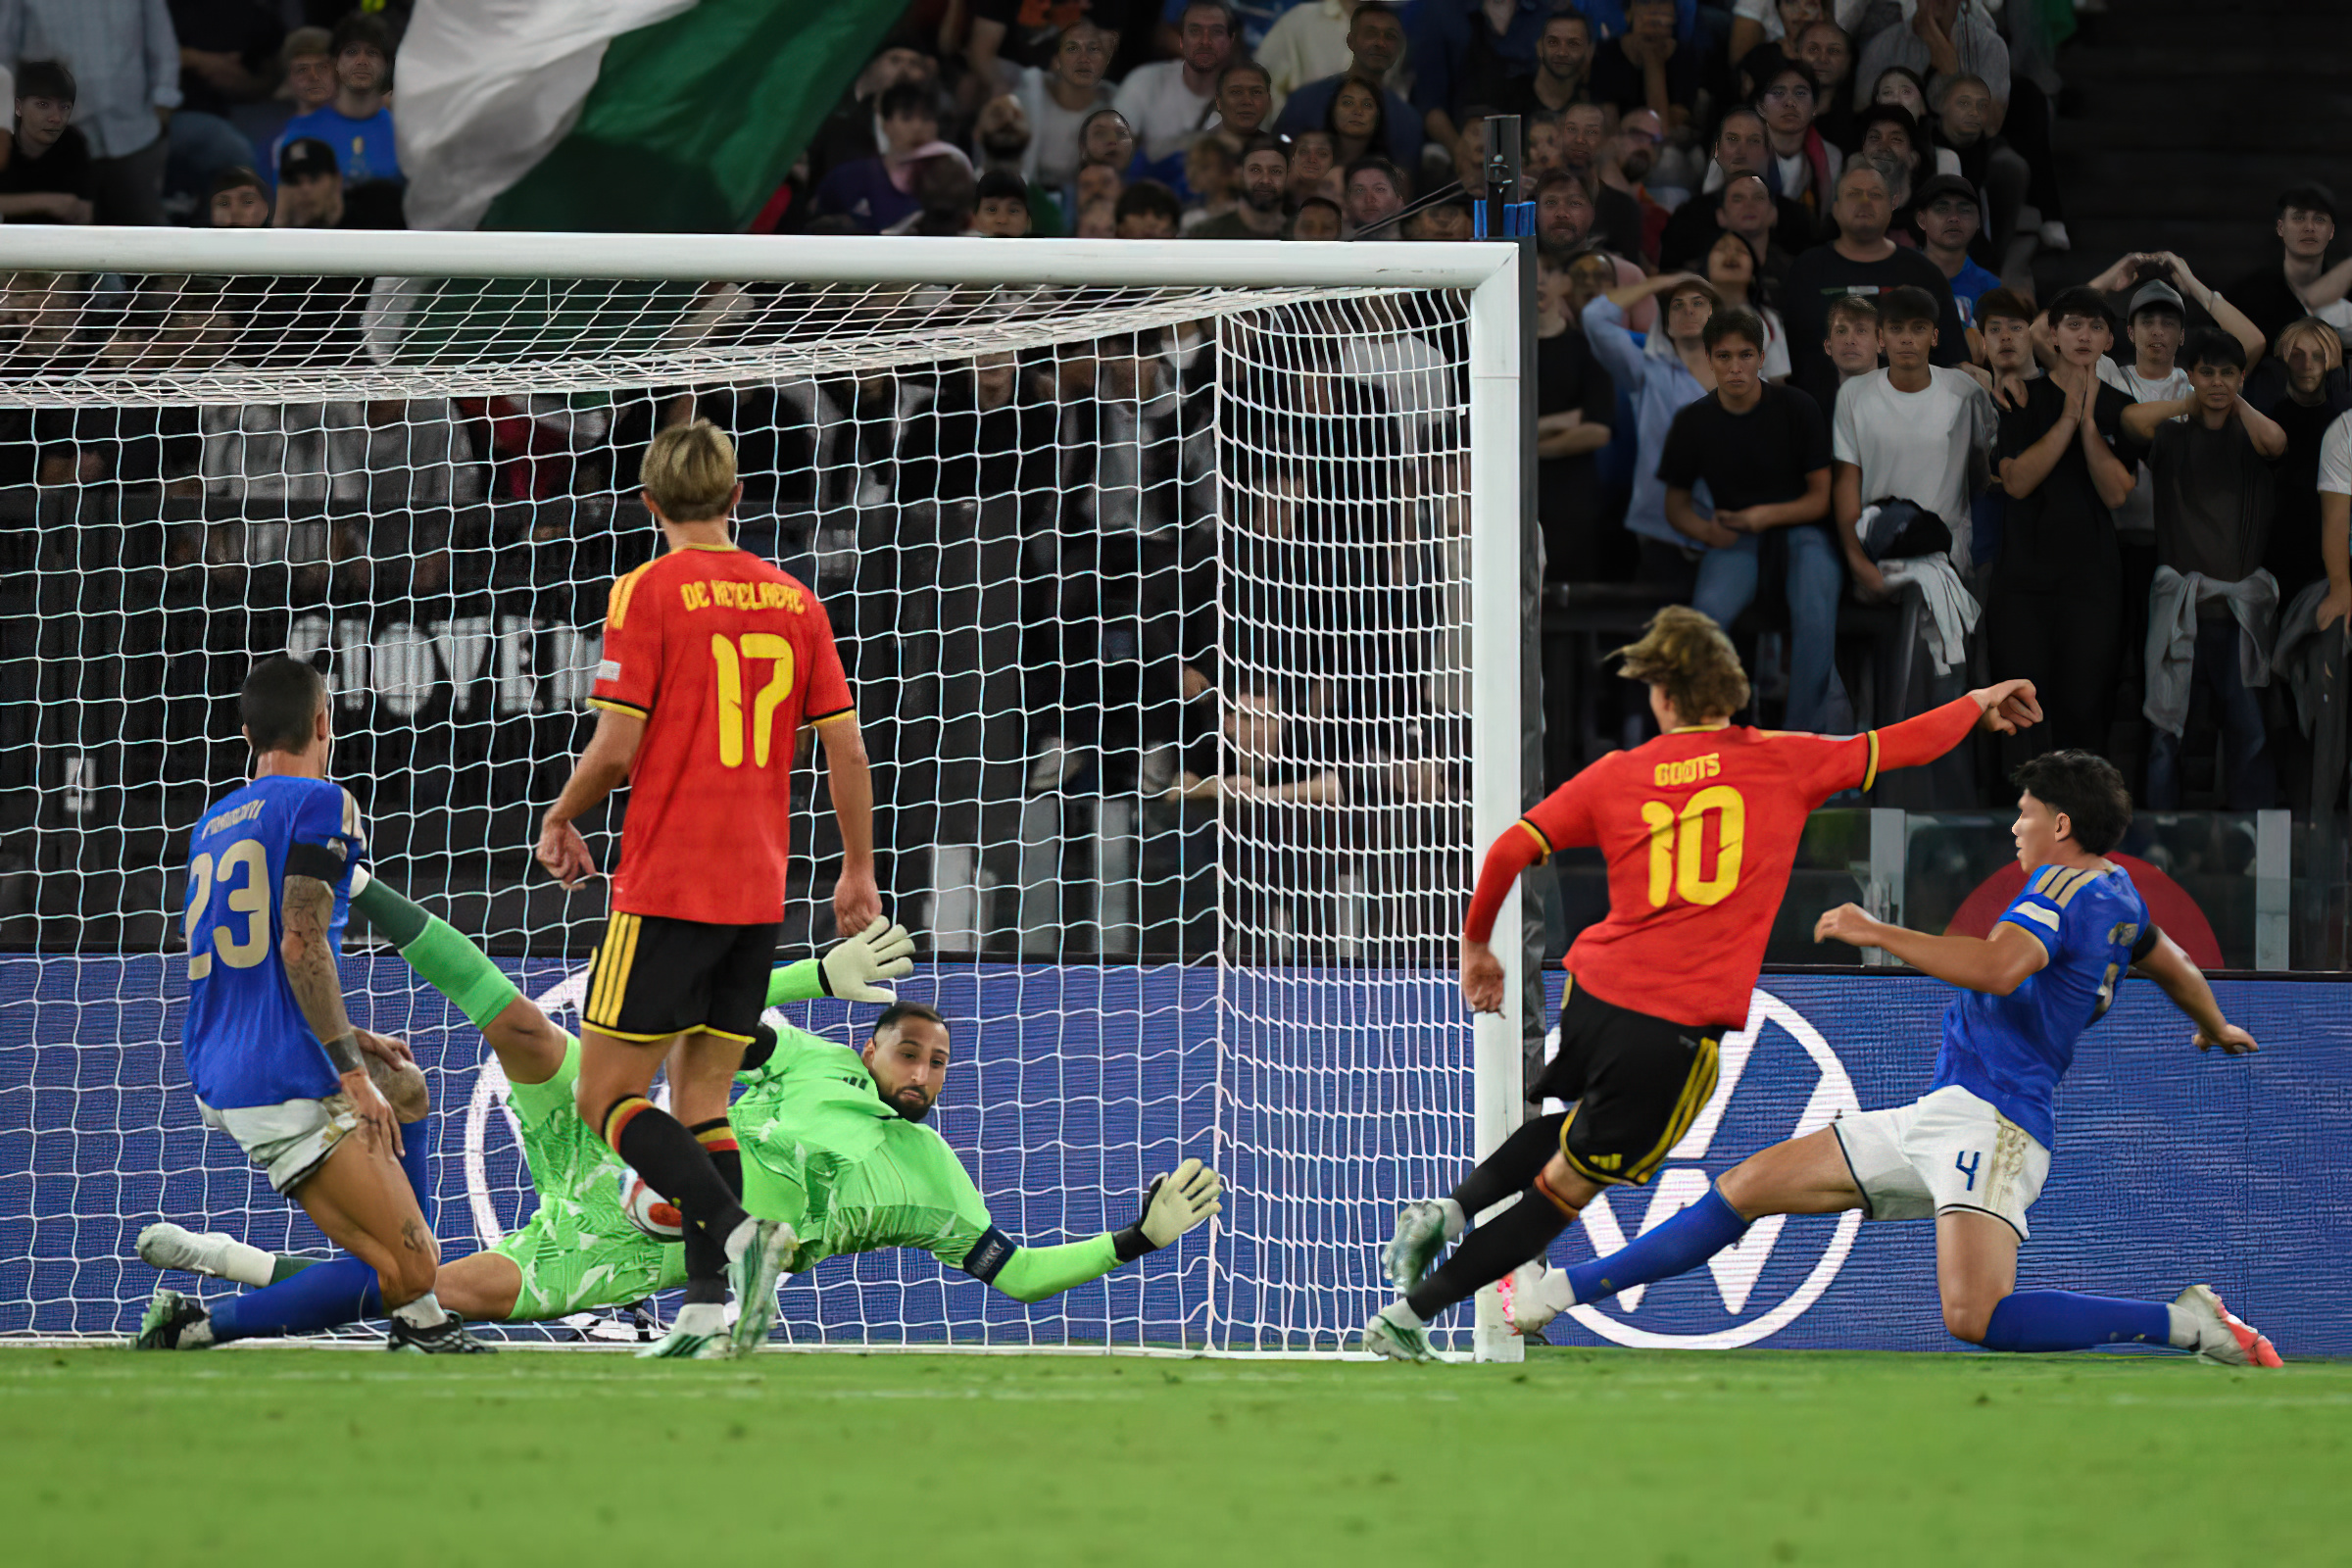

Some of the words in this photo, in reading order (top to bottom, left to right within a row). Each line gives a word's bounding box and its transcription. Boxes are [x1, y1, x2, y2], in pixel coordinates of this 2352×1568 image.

[711, 633, 794, 768] 17
[185, 839, 270, 980] 23
[1641, 785, 1744, 908] 10
[1956, 1151, 1981, 1191] 4
